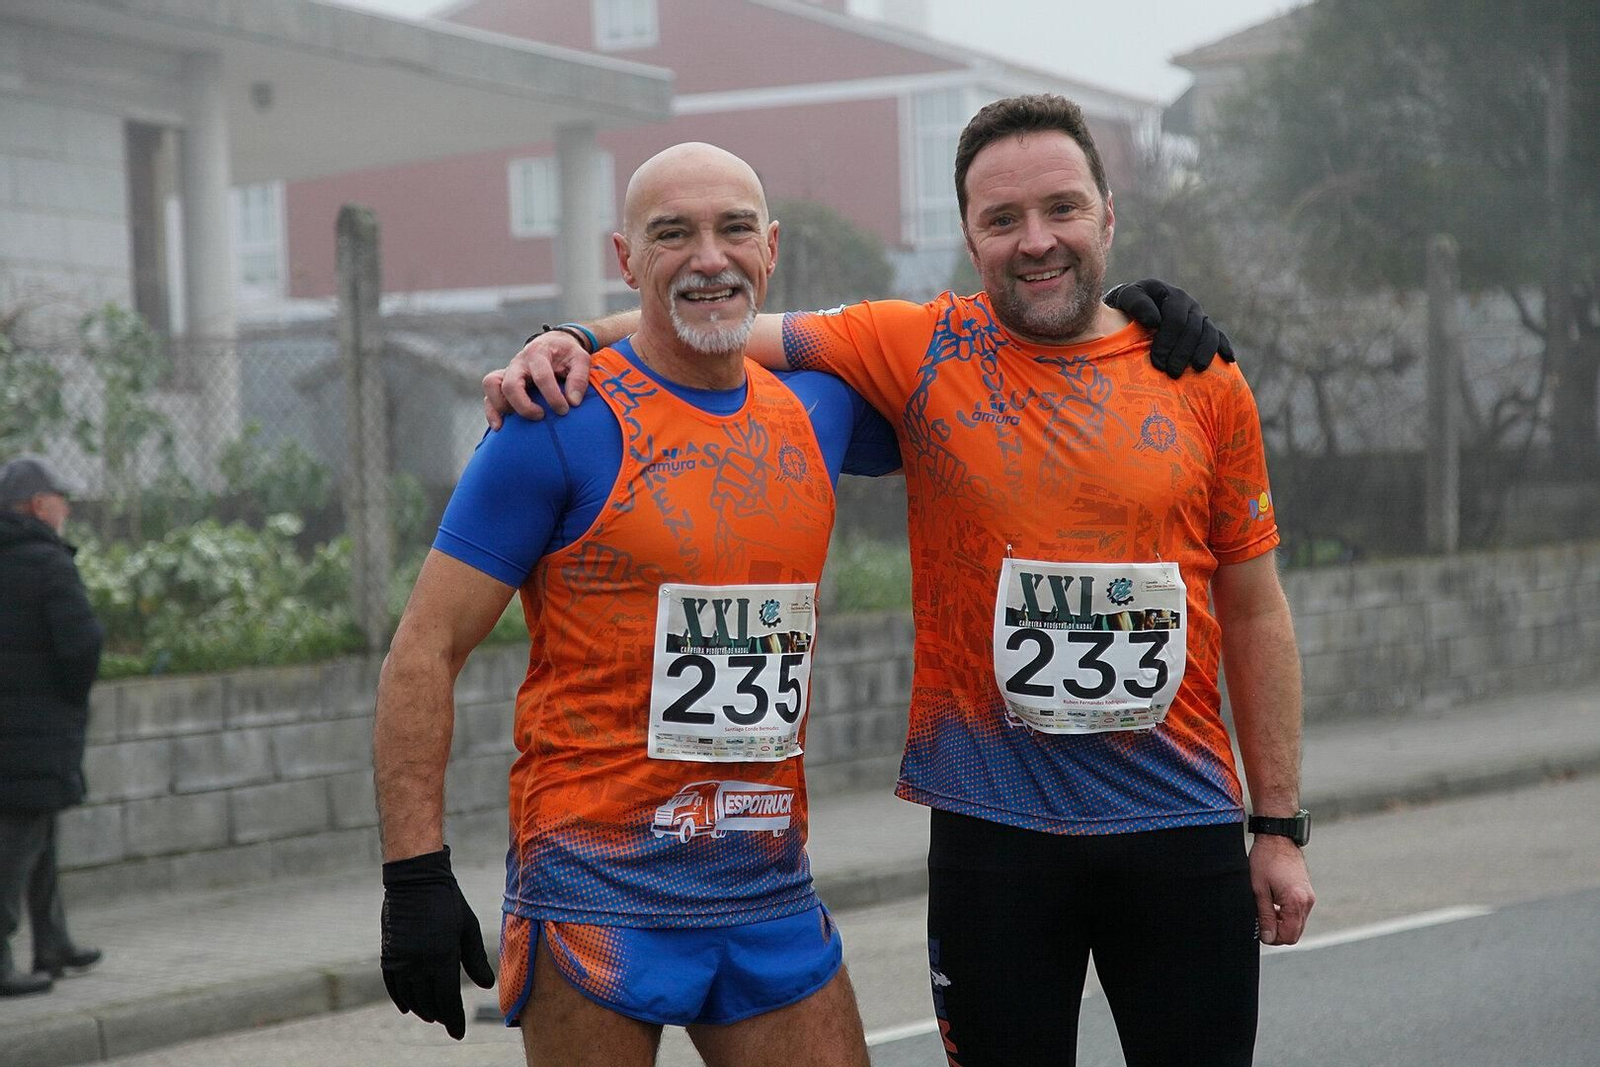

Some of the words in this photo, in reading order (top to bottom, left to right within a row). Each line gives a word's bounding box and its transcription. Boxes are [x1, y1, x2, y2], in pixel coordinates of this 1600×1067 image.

[971, 411, 1021, 426] amura
[646, 460, 696, 474] amura
[678, 597, 751, 646] XXI
[1019, 572, 1095, 623] XXI
[1005, 628, 1171, 700] 233
[662, 654, 805, 725] 235
[724, 793, 795, 815] ESPOTRUCK
